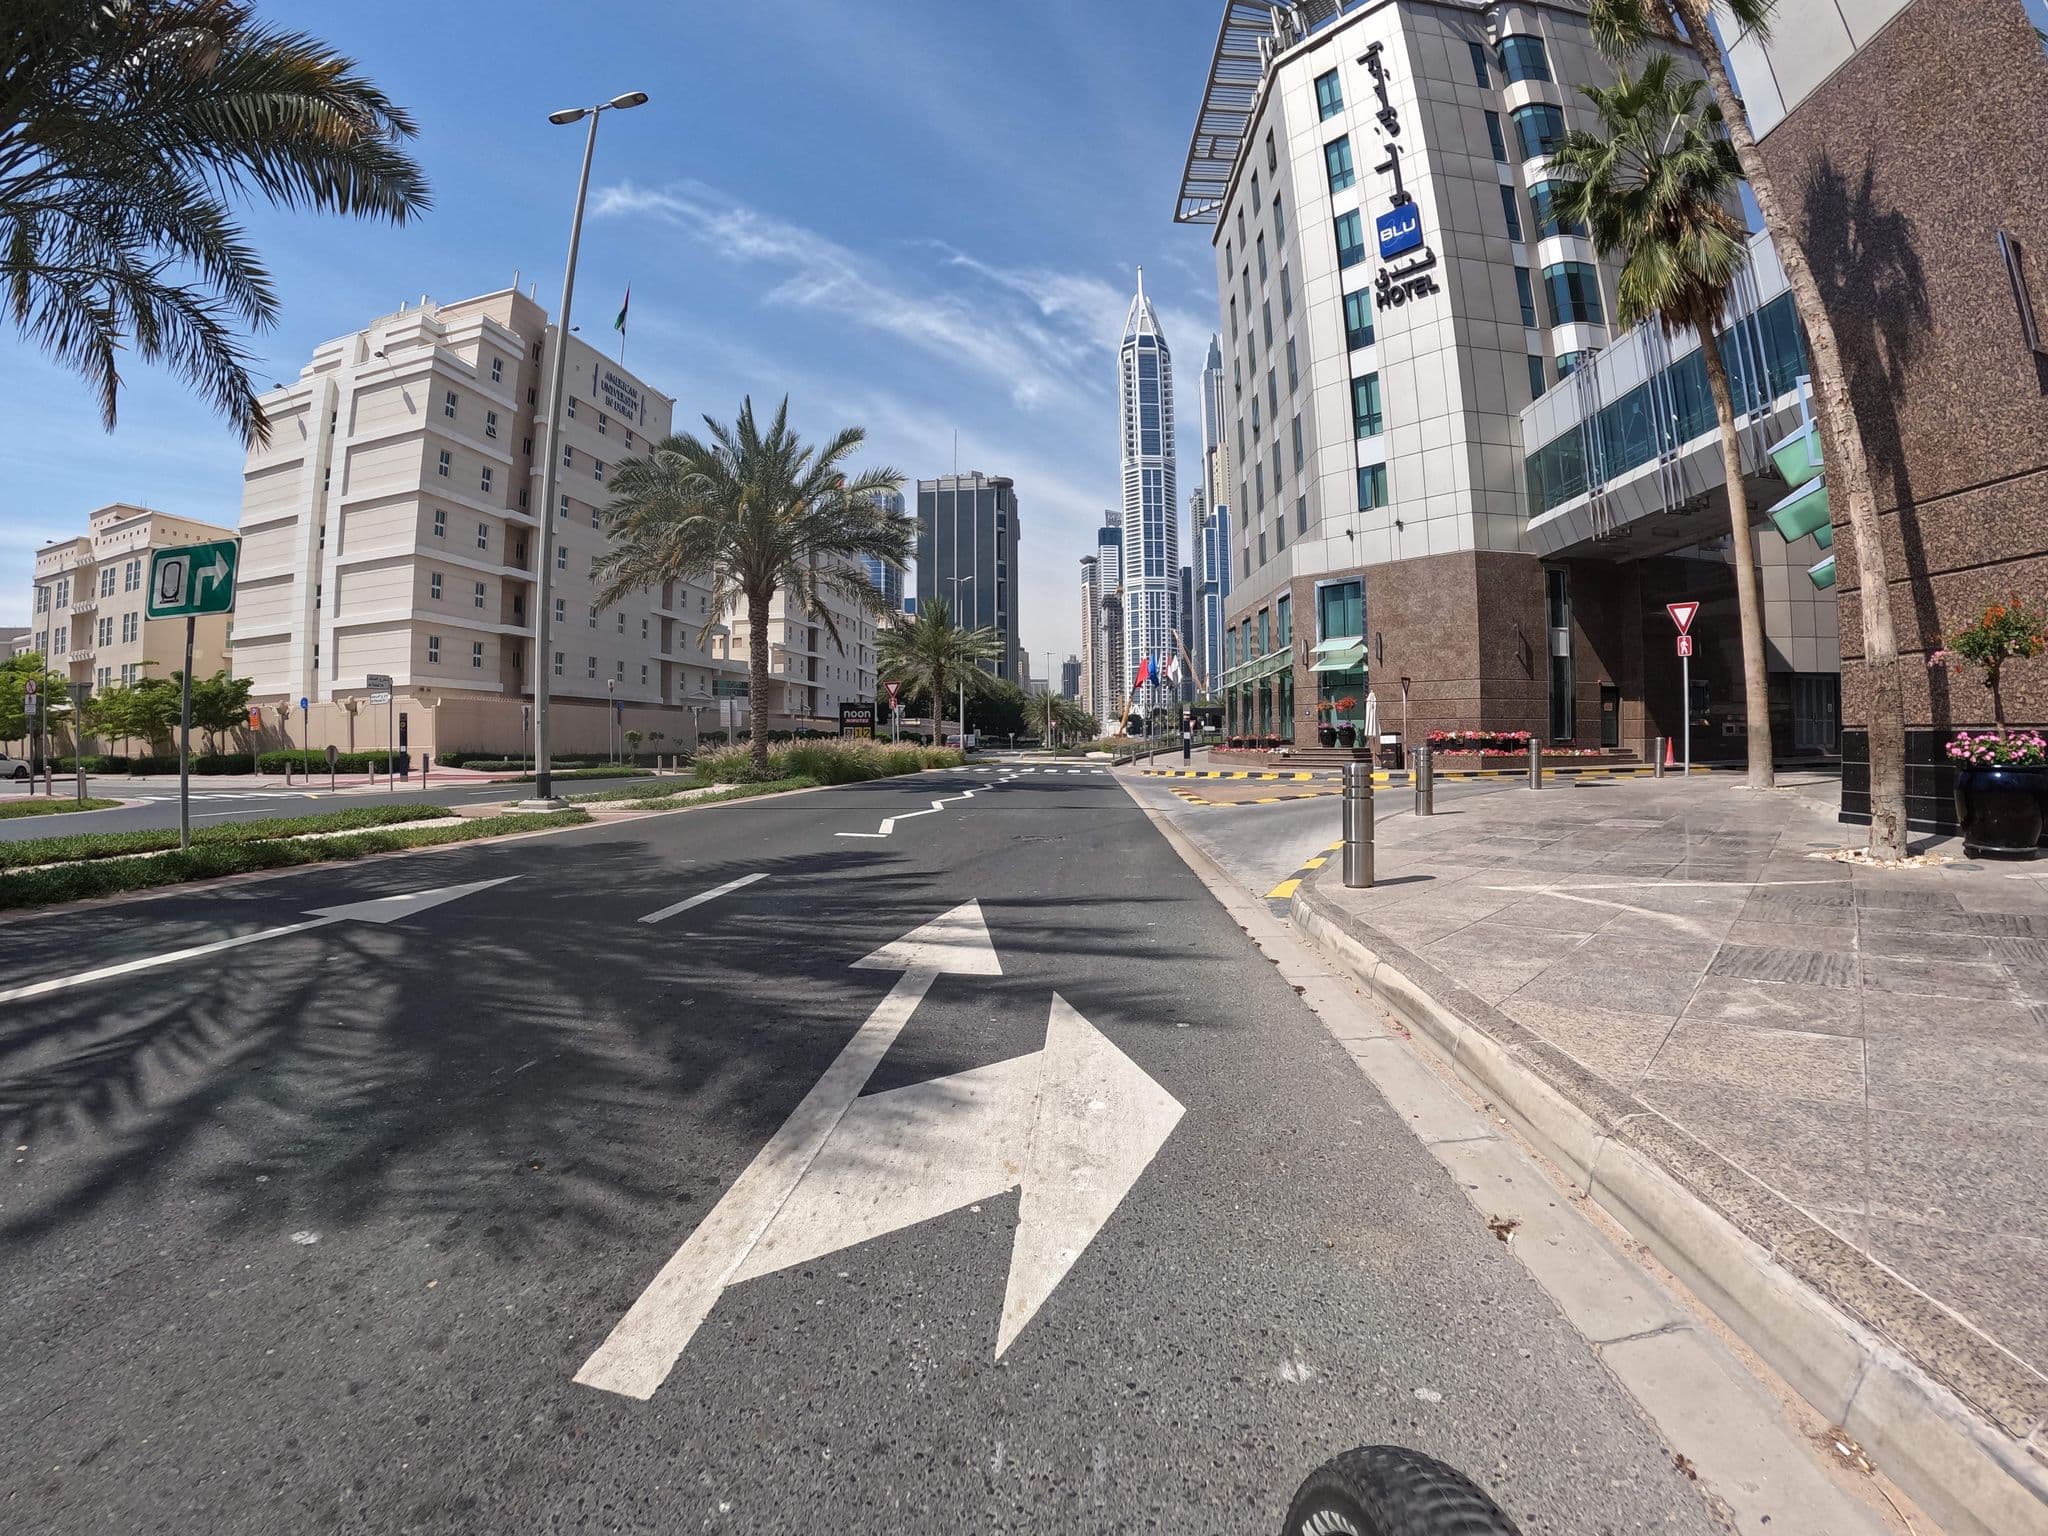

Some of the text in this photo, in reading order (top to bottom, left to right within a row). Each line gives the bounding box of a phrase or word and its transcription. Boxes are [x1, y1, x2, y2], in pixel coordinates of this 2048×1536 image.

[1380, 218, 1416, 243] BLU
[1375, 274, 1441, 313] HOTEL
[601, 379, 640, 412] UNIVERSITY
[605, 371, 638, 399] AMERICAN
[614, 401, 633, 421] DUBAI
[844, 710, 871, 718] noon
